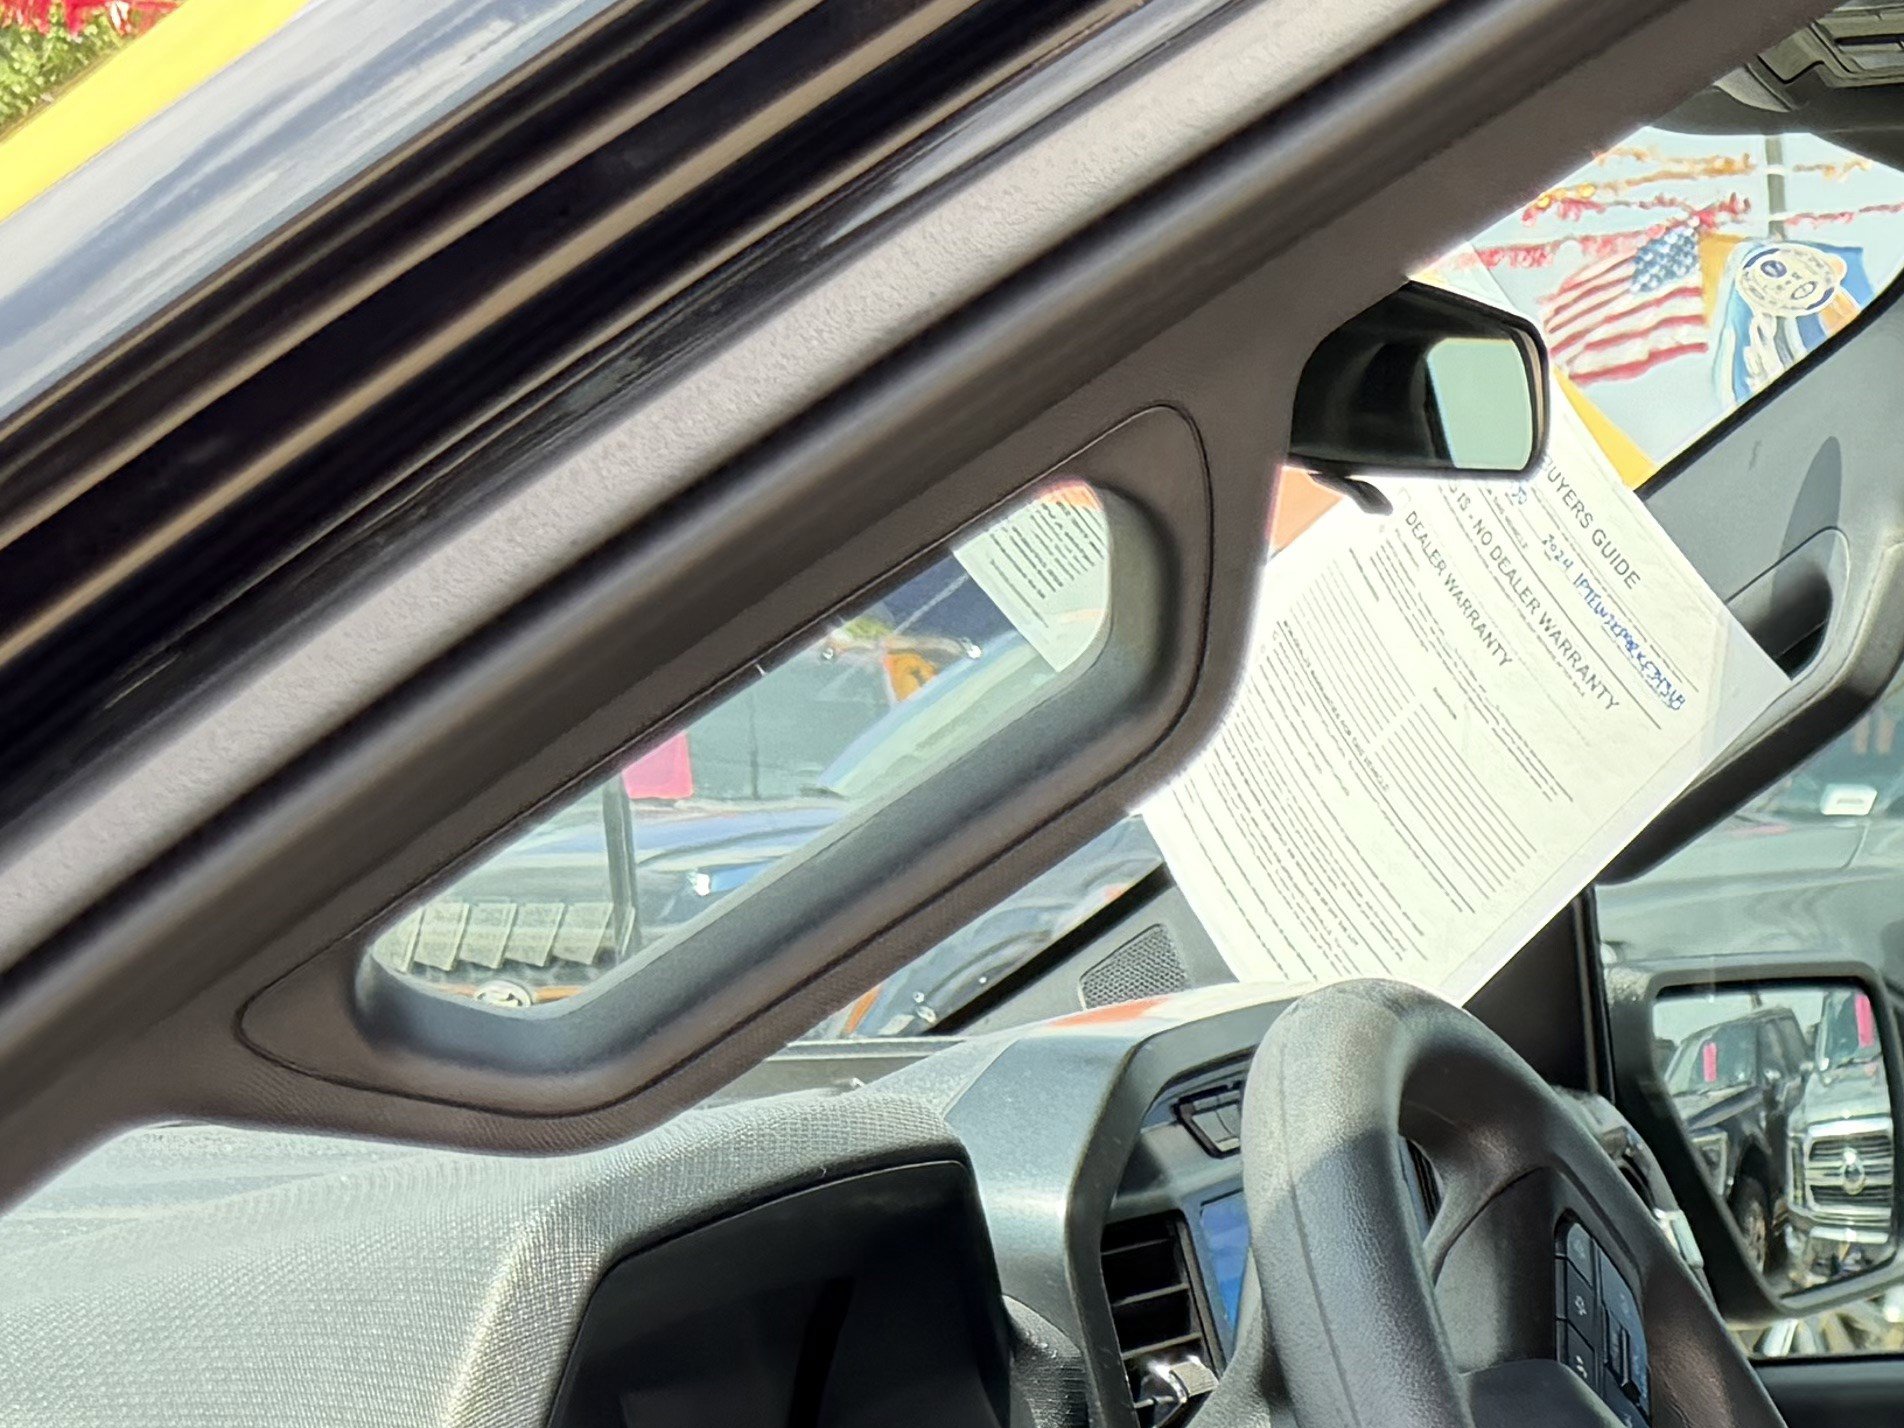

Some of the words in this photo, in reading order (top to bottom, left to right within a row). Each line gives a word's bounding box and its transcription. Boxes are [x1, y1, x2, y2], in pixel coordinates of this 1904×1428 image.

[1405, 510, 1447, 577] DEALER
[1443, 571, 1514, 669] WARRANTY
[1472, 518, 1493, 547] NO
[1489, 546, 1541, 616] DEALER
[1538, 609, 1620, 712] WARRANTY
[1592, 528, 1641, 589] GUIDE
